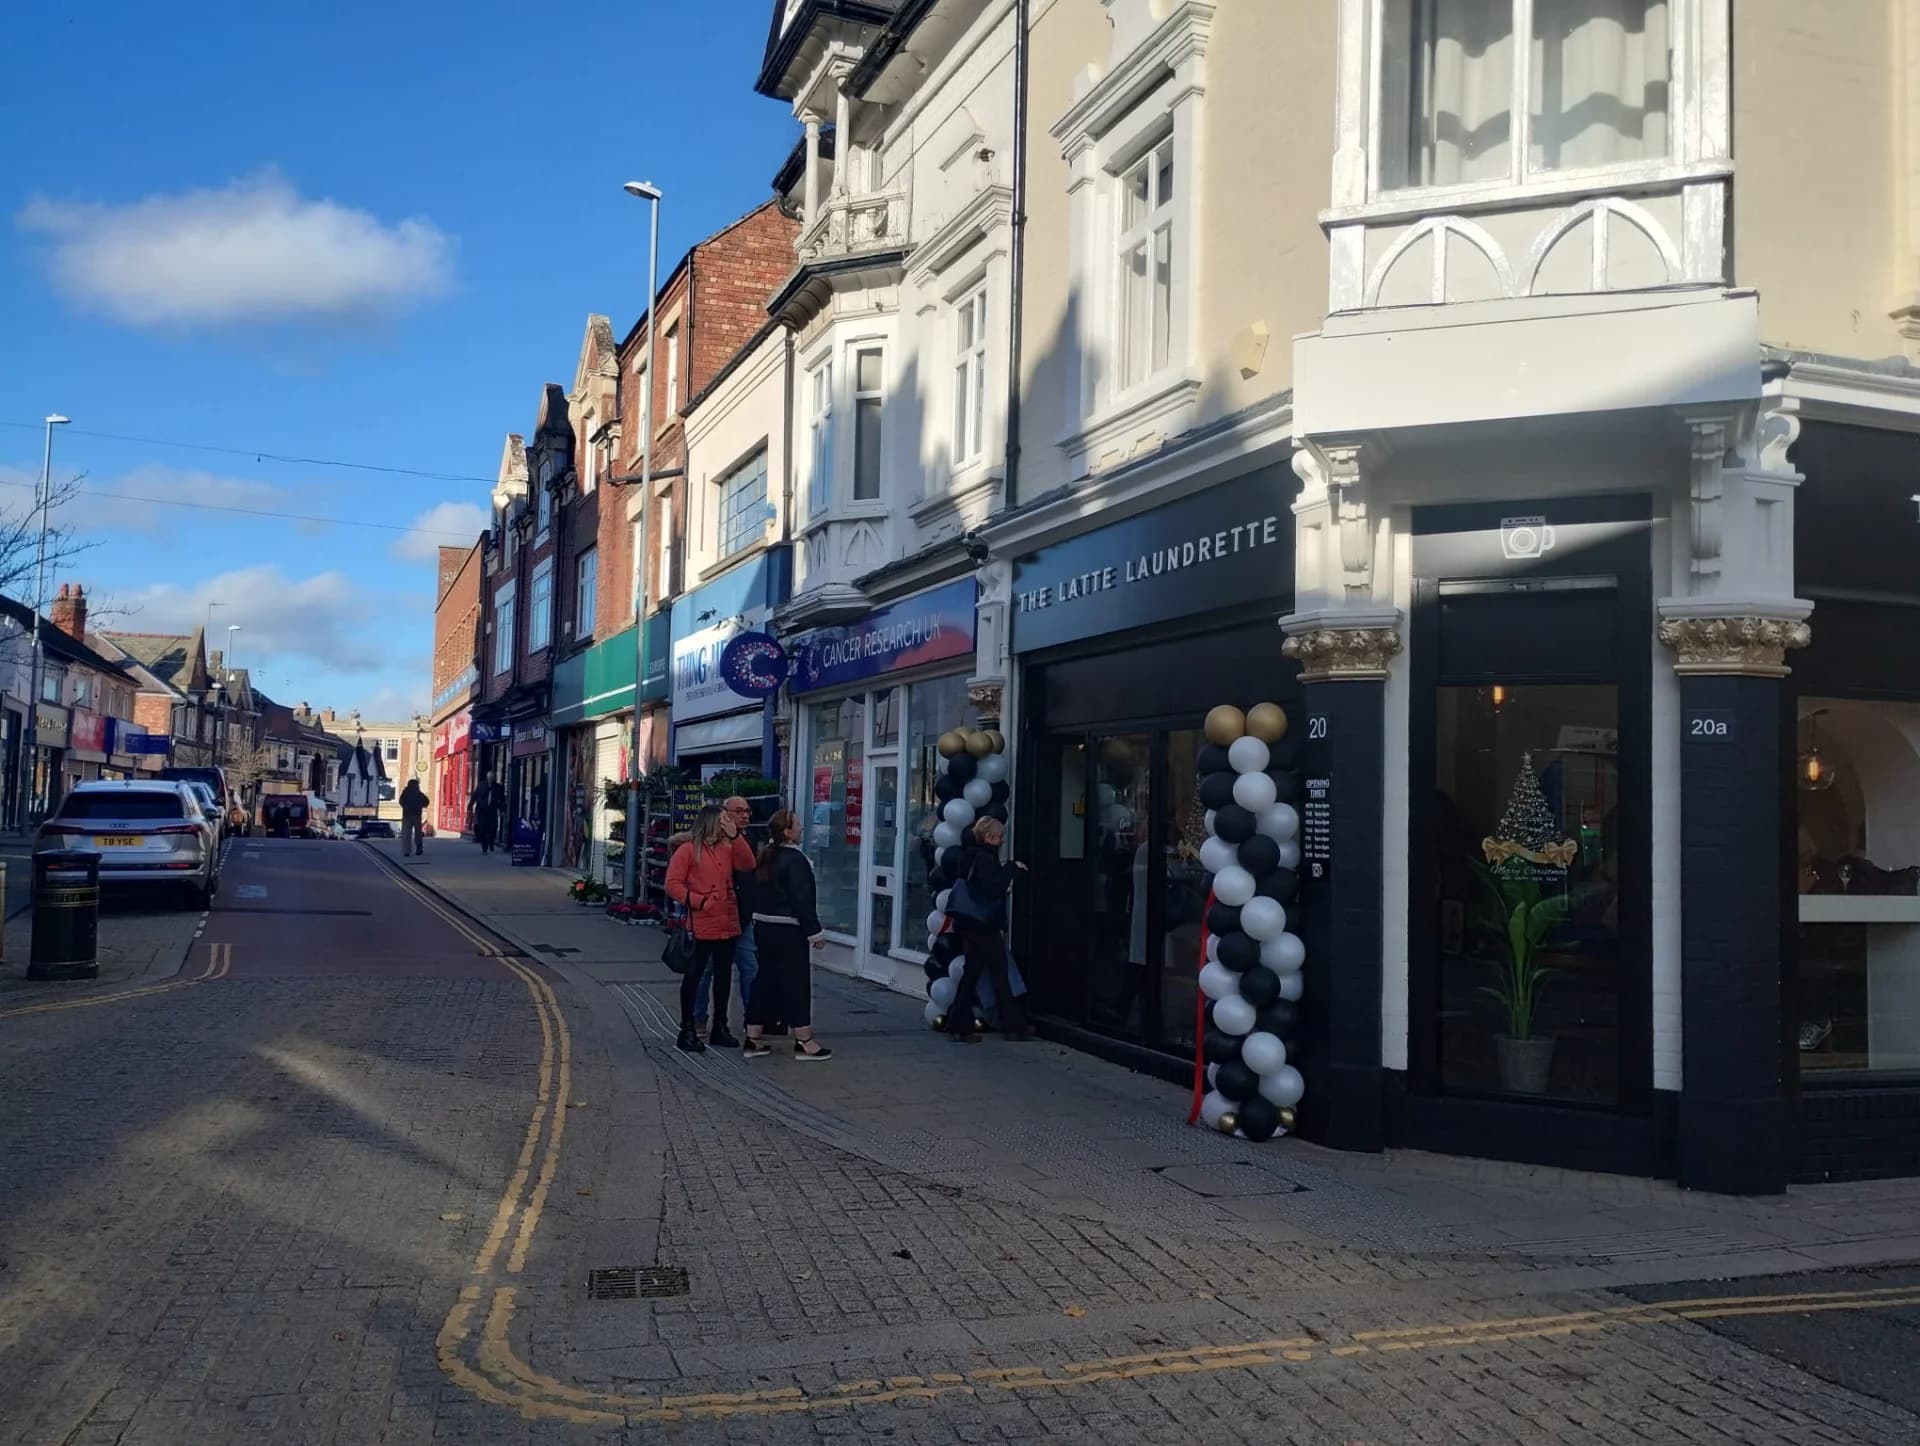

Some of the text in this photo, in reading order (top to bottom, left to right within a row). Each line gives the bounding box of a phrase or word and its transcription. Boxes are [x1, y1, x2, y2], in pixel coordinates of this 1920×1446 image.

[1019, 516, 1278, 612] THE LATTE LAUNDRETTE
[823, 613, 942, 669] CANCER RESEARCH UK
[1309, 717, 1327, 739] 20
[1691, 719, 1727, 735] 20a
[1305, 778, 1330, 789] OPENING
[1310, 789, 1326, 799] TIMES
